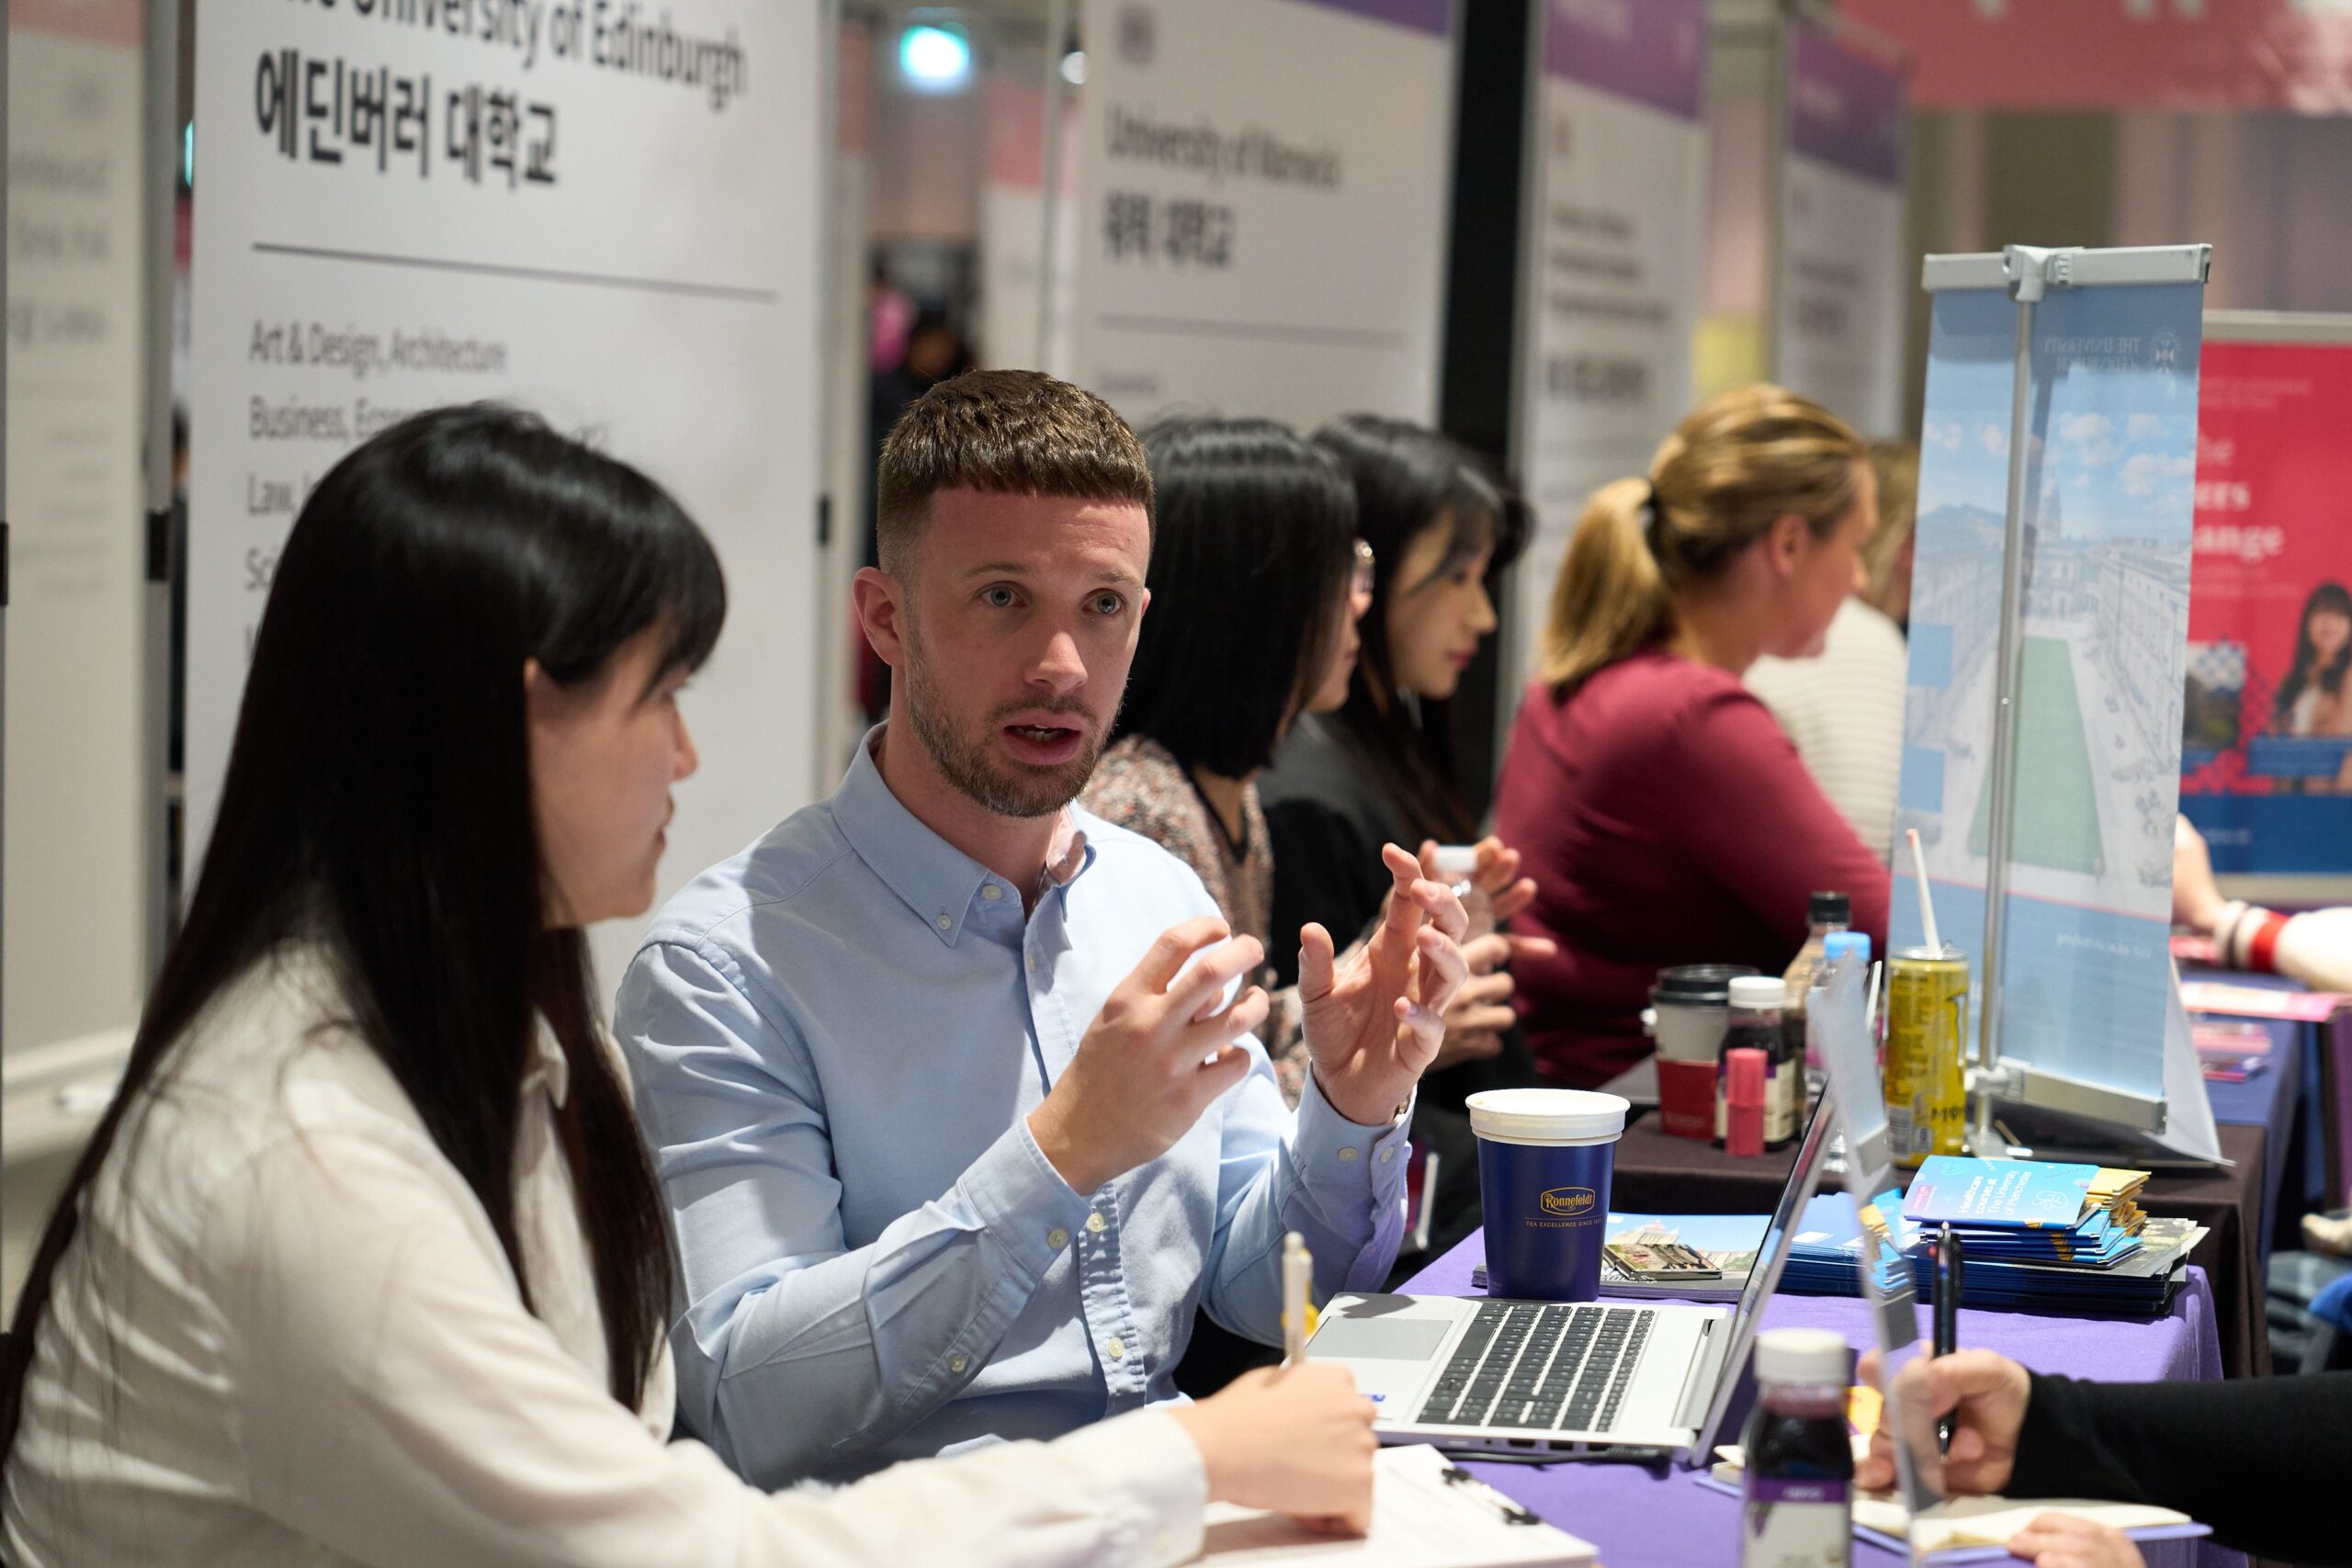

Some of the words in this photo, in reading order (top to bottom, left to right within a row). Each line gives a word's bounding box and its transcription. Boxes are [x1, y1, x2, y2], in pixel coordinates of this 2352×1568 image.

[593, 0, 749, 112] Edinburgh
[256, 48, 430, 178] 에딘버러
[447, 85, 558, 190] 대학교
[249, 321, 285, 365] Art
[1544, 1193, 1592, 1209] Ronnefeldt
[1957, 1175, 1984, 1213] Healthcare
[1975, 1185, 1994, 1214] courses
[1993, 1170, 2020, 1199] University
[2006, 1171, 2031, 1206] Manchester
[1987, 1199, 2003, 1214] The
